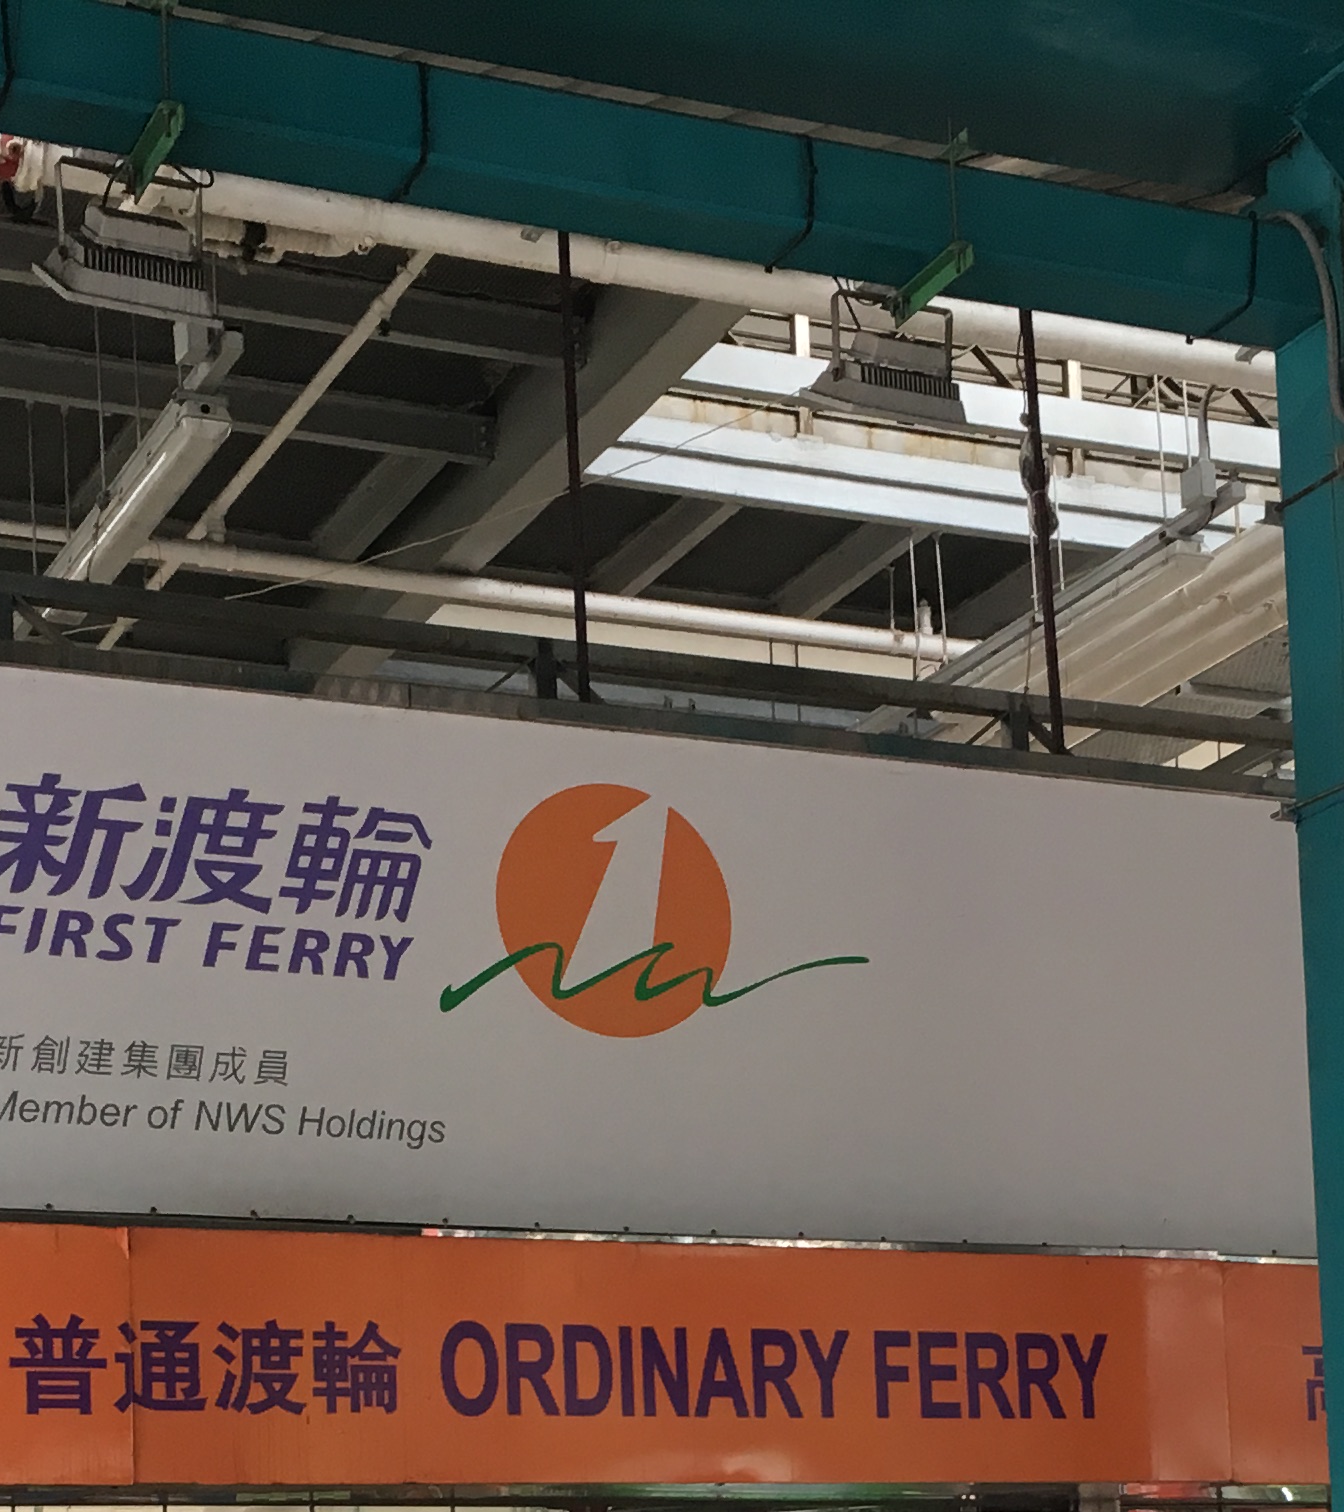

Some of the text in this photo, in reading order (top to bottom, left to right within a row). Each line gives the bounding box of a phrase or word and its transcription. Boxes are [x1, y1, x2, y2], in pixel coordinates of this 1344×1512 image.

[202, 921, 415, 983] FERRY
[146, 1098, 183, 1132] of
[194, 1102, 286, 1137] NWS
[299, 1105, 447, 1150] Holdings
[9, 1314, 402, 1416] 普通渡輪
[439, 1320, 1108, 1420] ORDINARY FERRY
